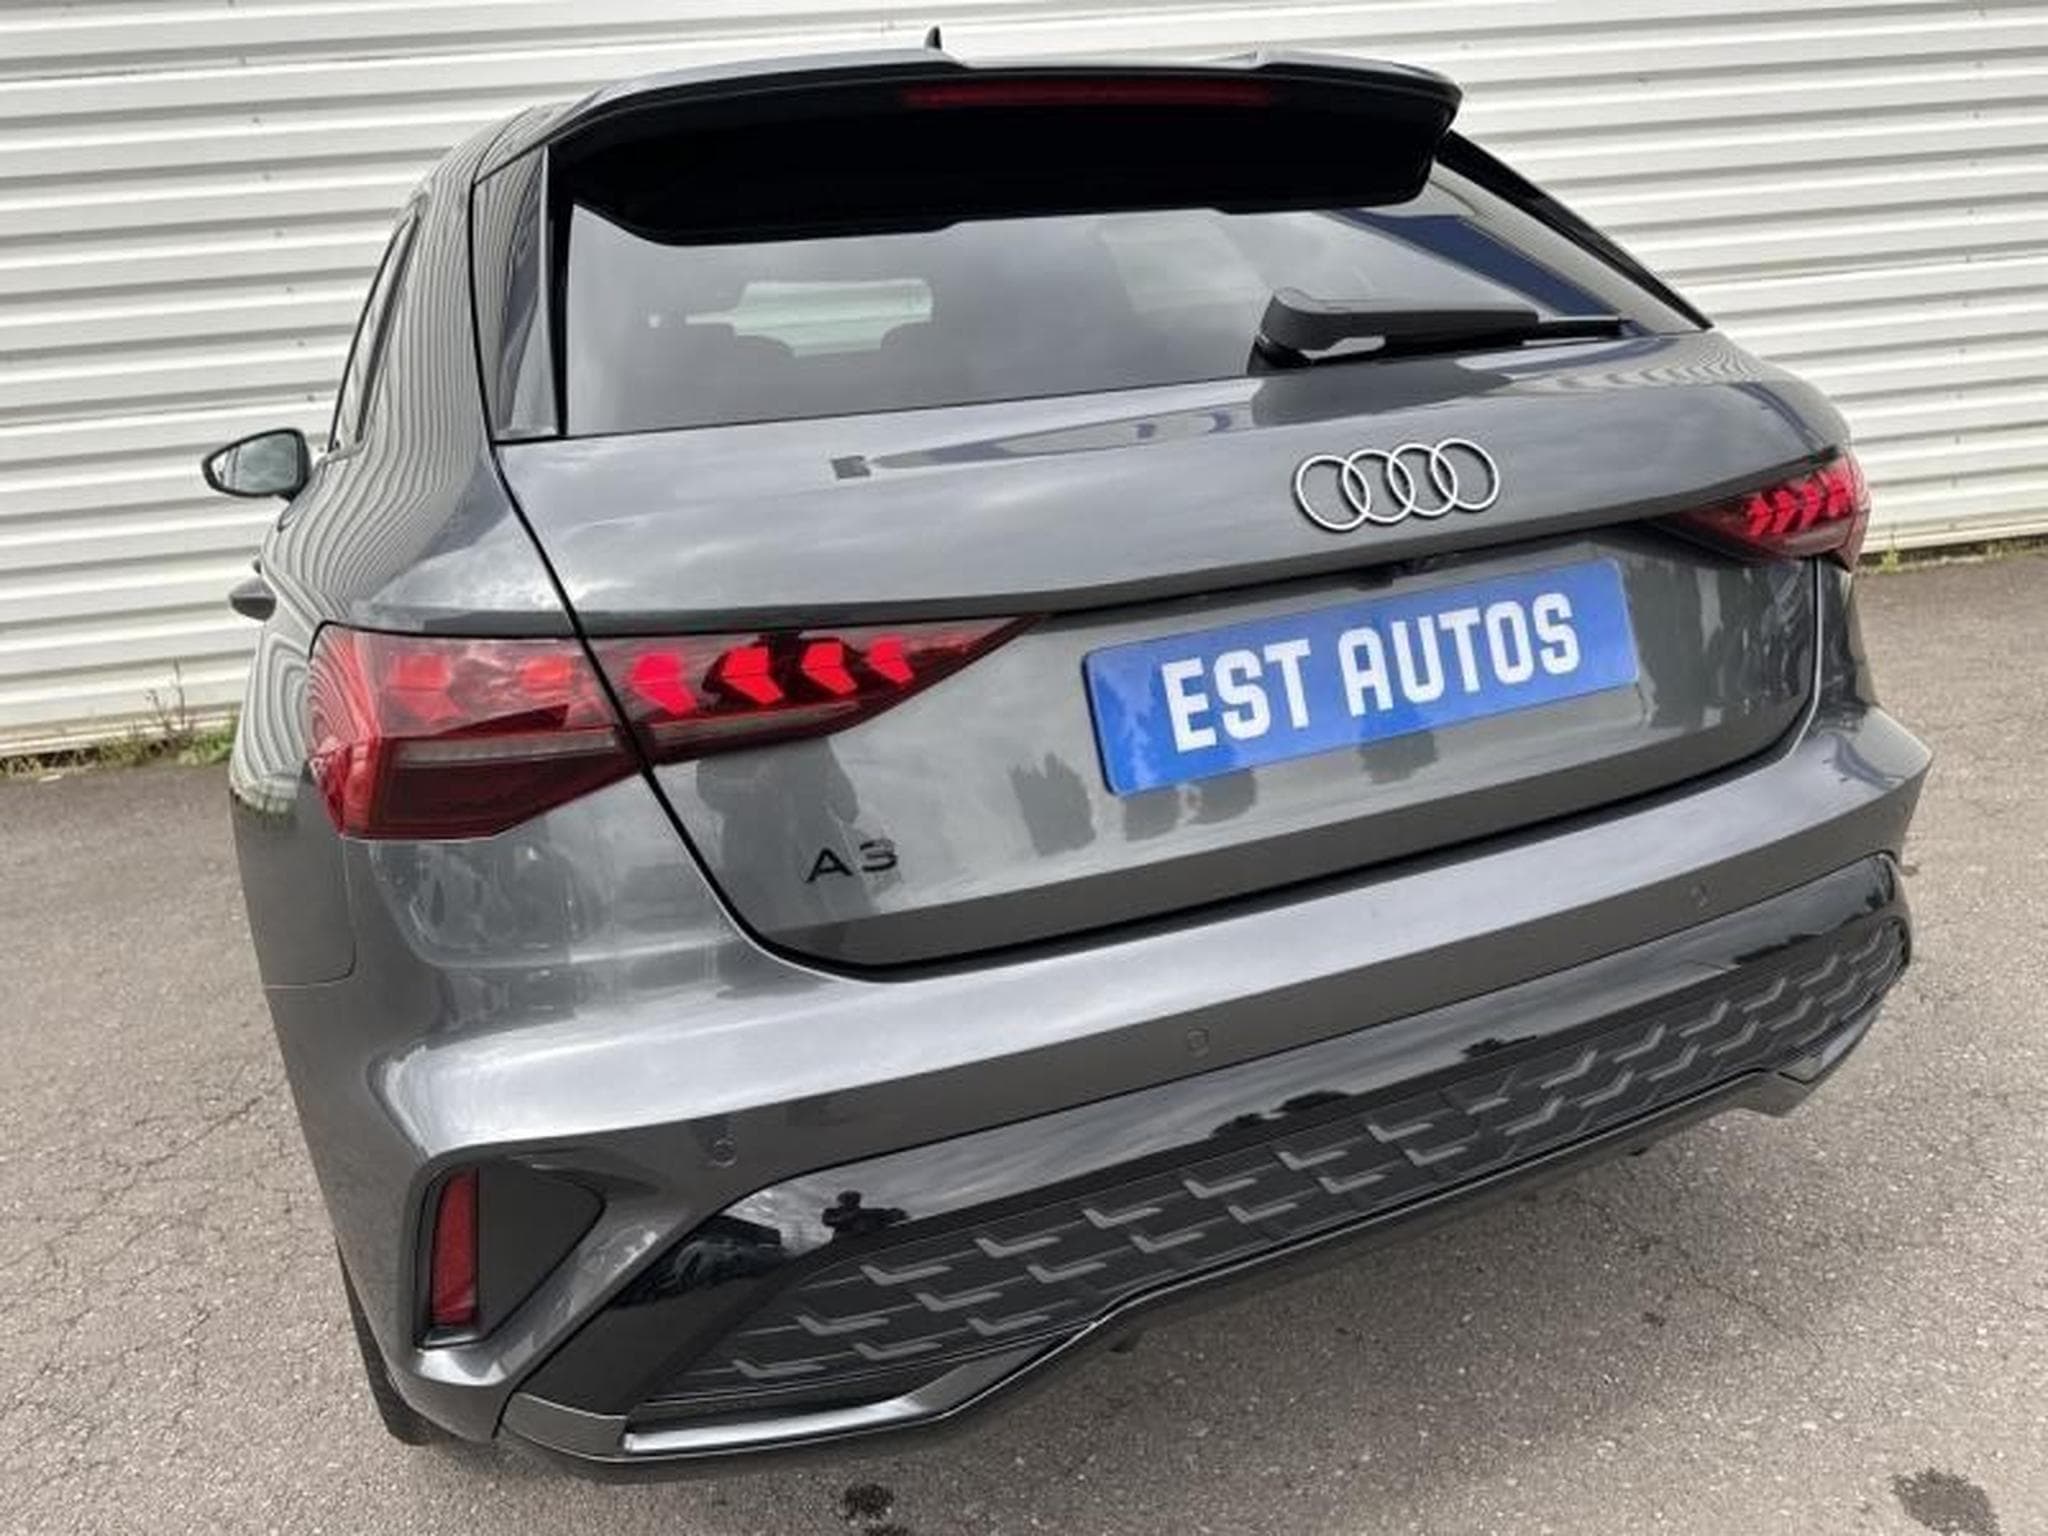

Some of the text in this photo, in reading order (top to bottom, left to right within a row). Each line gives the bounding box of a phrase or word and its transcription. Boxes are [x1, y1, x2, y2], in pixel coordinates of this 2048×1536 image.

[1161, 592, 1581, 754] EST AUTOS
[805, 838, 898, 883] A3
